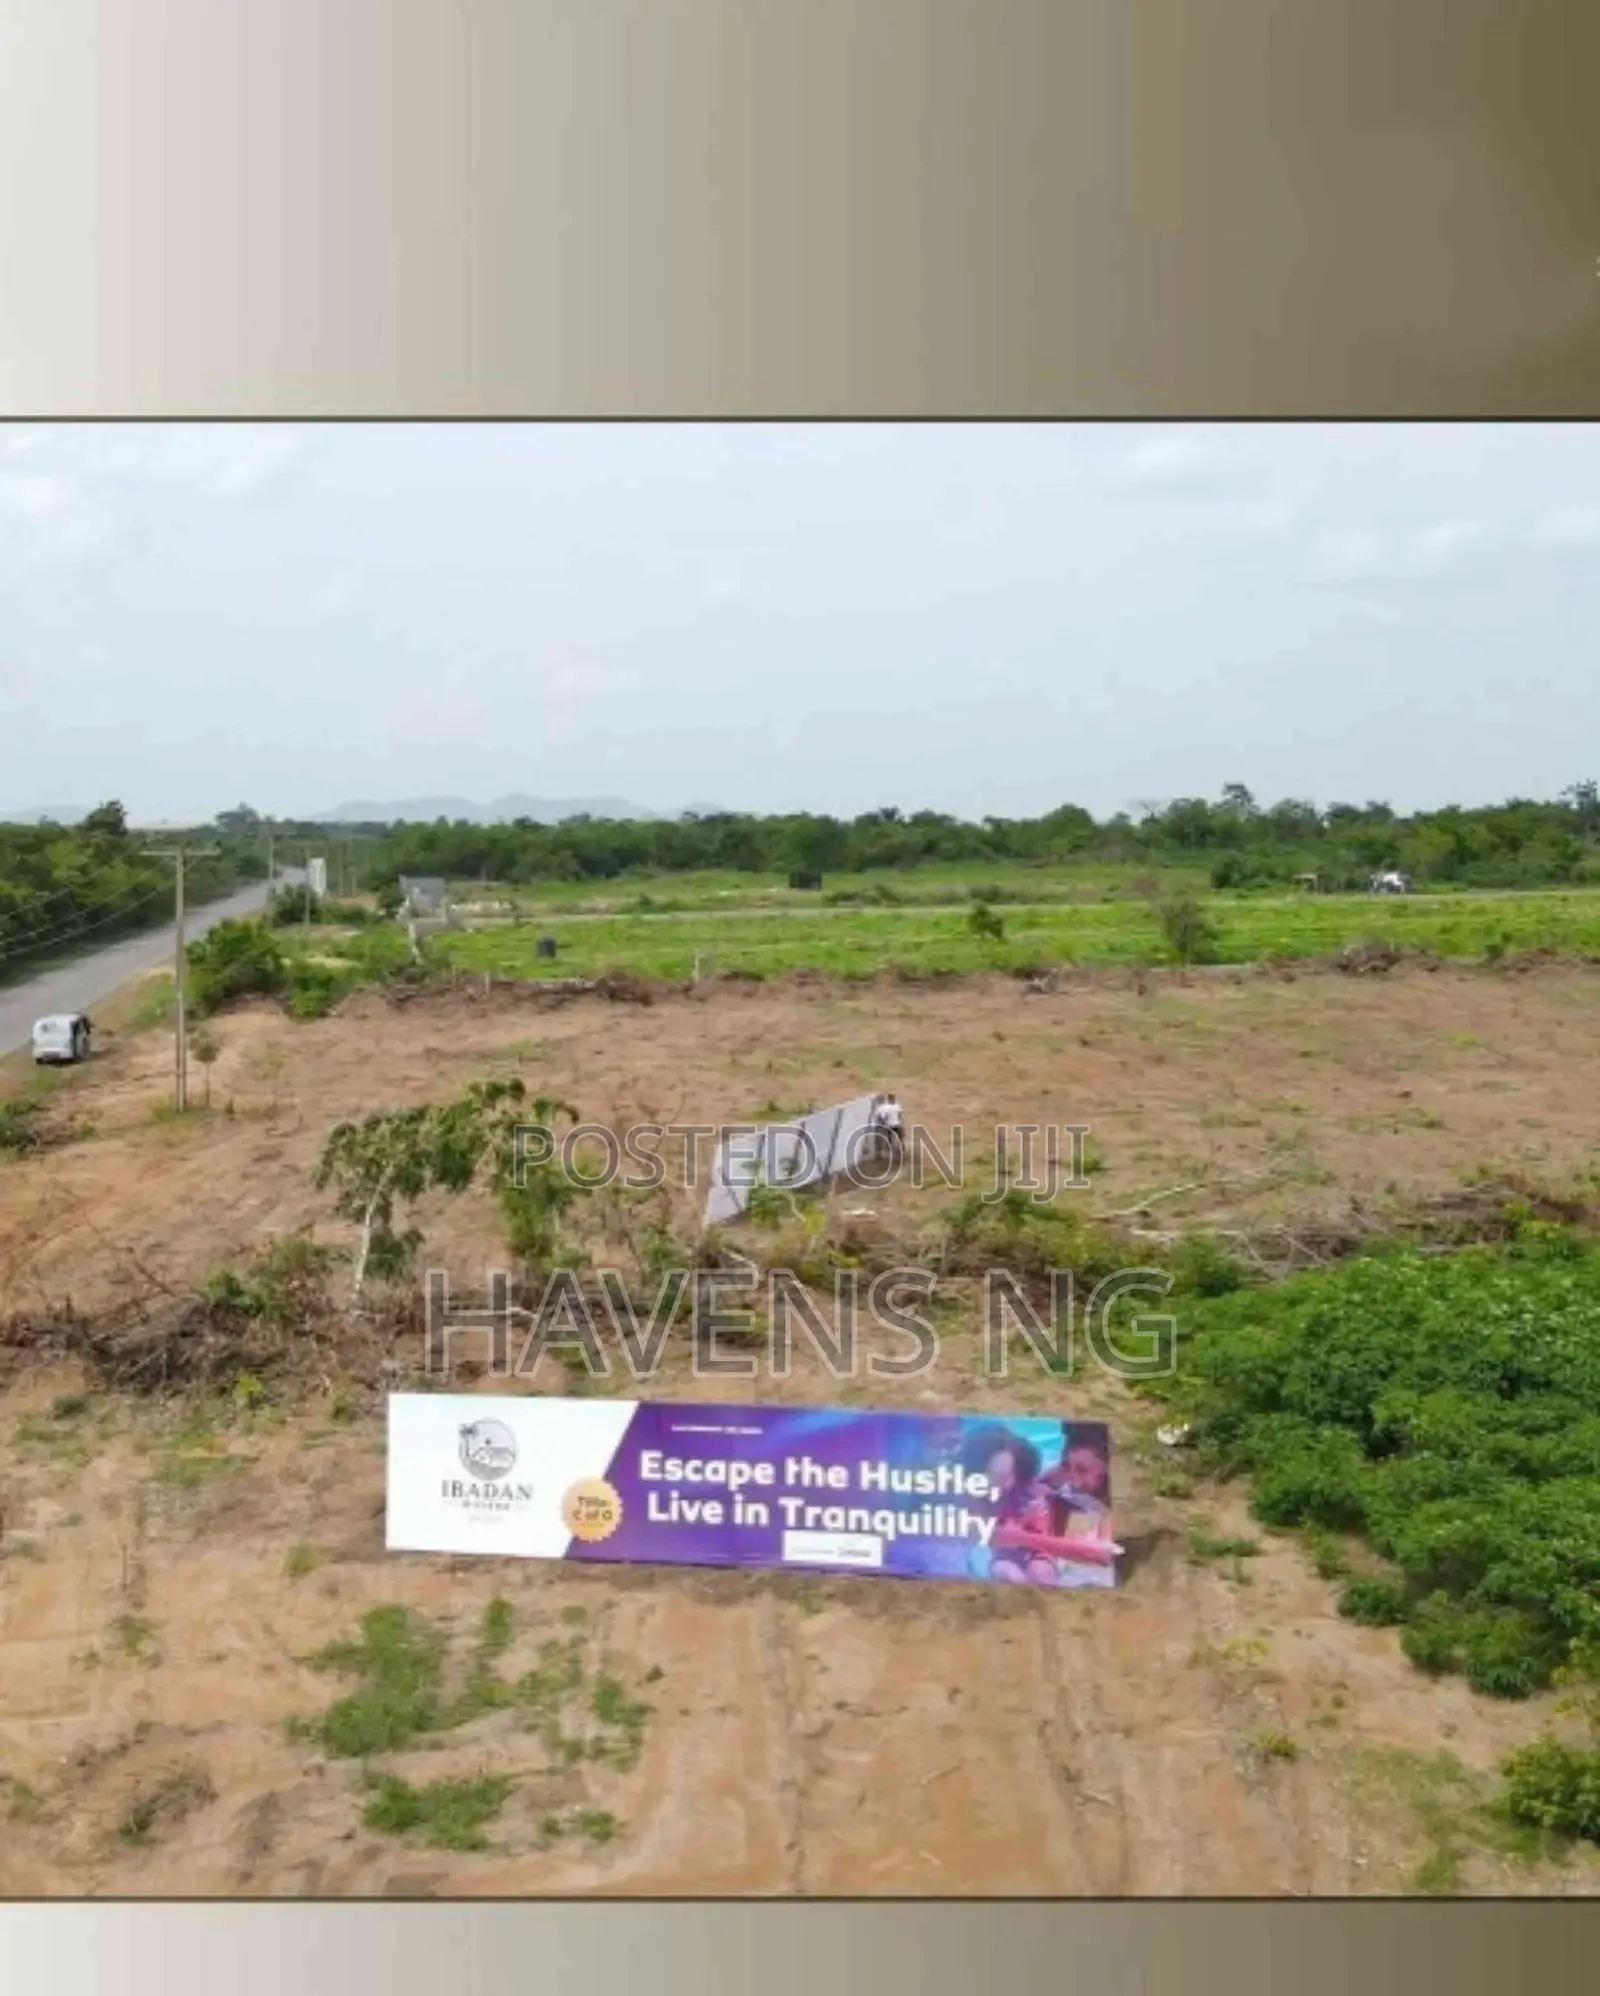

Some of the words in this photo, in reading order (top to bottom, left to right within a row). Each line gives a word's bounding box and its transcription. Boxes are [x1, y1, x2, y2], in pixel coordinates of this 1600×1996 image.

[441, 1480, 533, 1501] IBADAN
[639, 1449, 775, 1491] Escape
[784, 1456, 850, 1488] the
[860, 1462, 1000, 1502] Hustle,
[648, 1493, 724, 1525] Live
[733, 1496, 770, 1526] in
[779, 1499, 998, 1546] Tranquility
